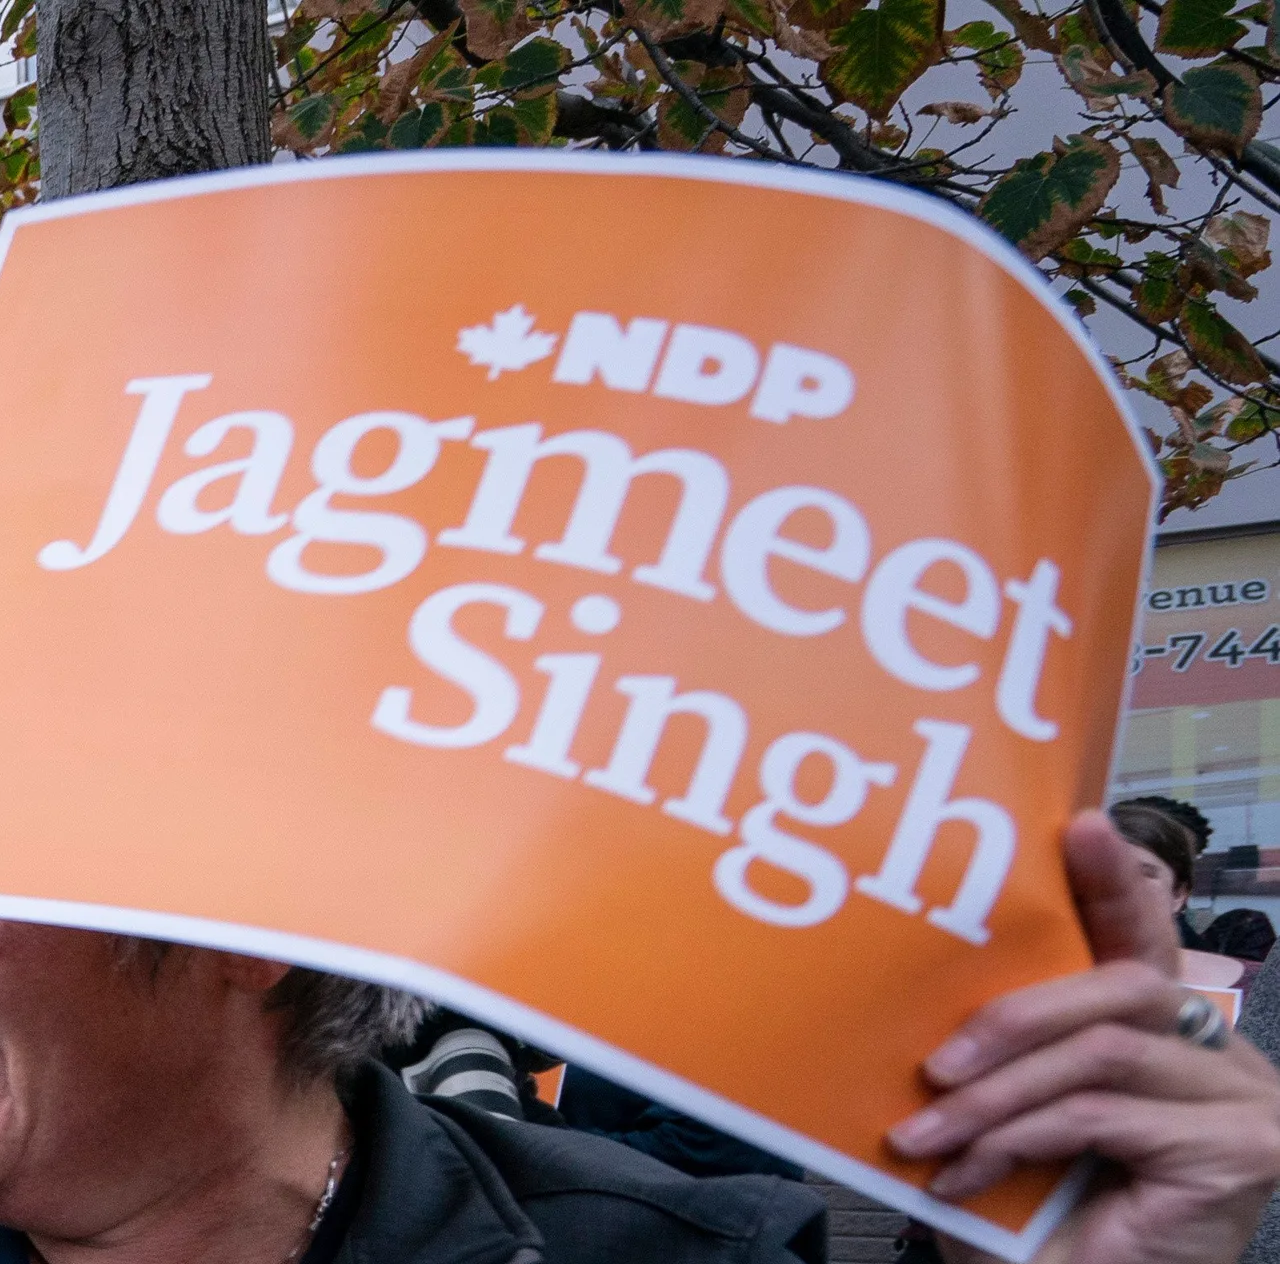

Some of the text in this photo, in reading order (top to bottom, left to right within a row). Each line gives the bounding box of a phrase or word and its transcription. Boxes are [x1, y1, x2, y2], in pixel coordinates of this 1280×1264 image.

[550, 309, 858, 426] NDP
[35, 372, 1074, 742] Jagmeet
[1145, 579, 1268, 611] enue
[1130, 626, 1280, 674] -744
[368, 581, 1018, 946] Singh
